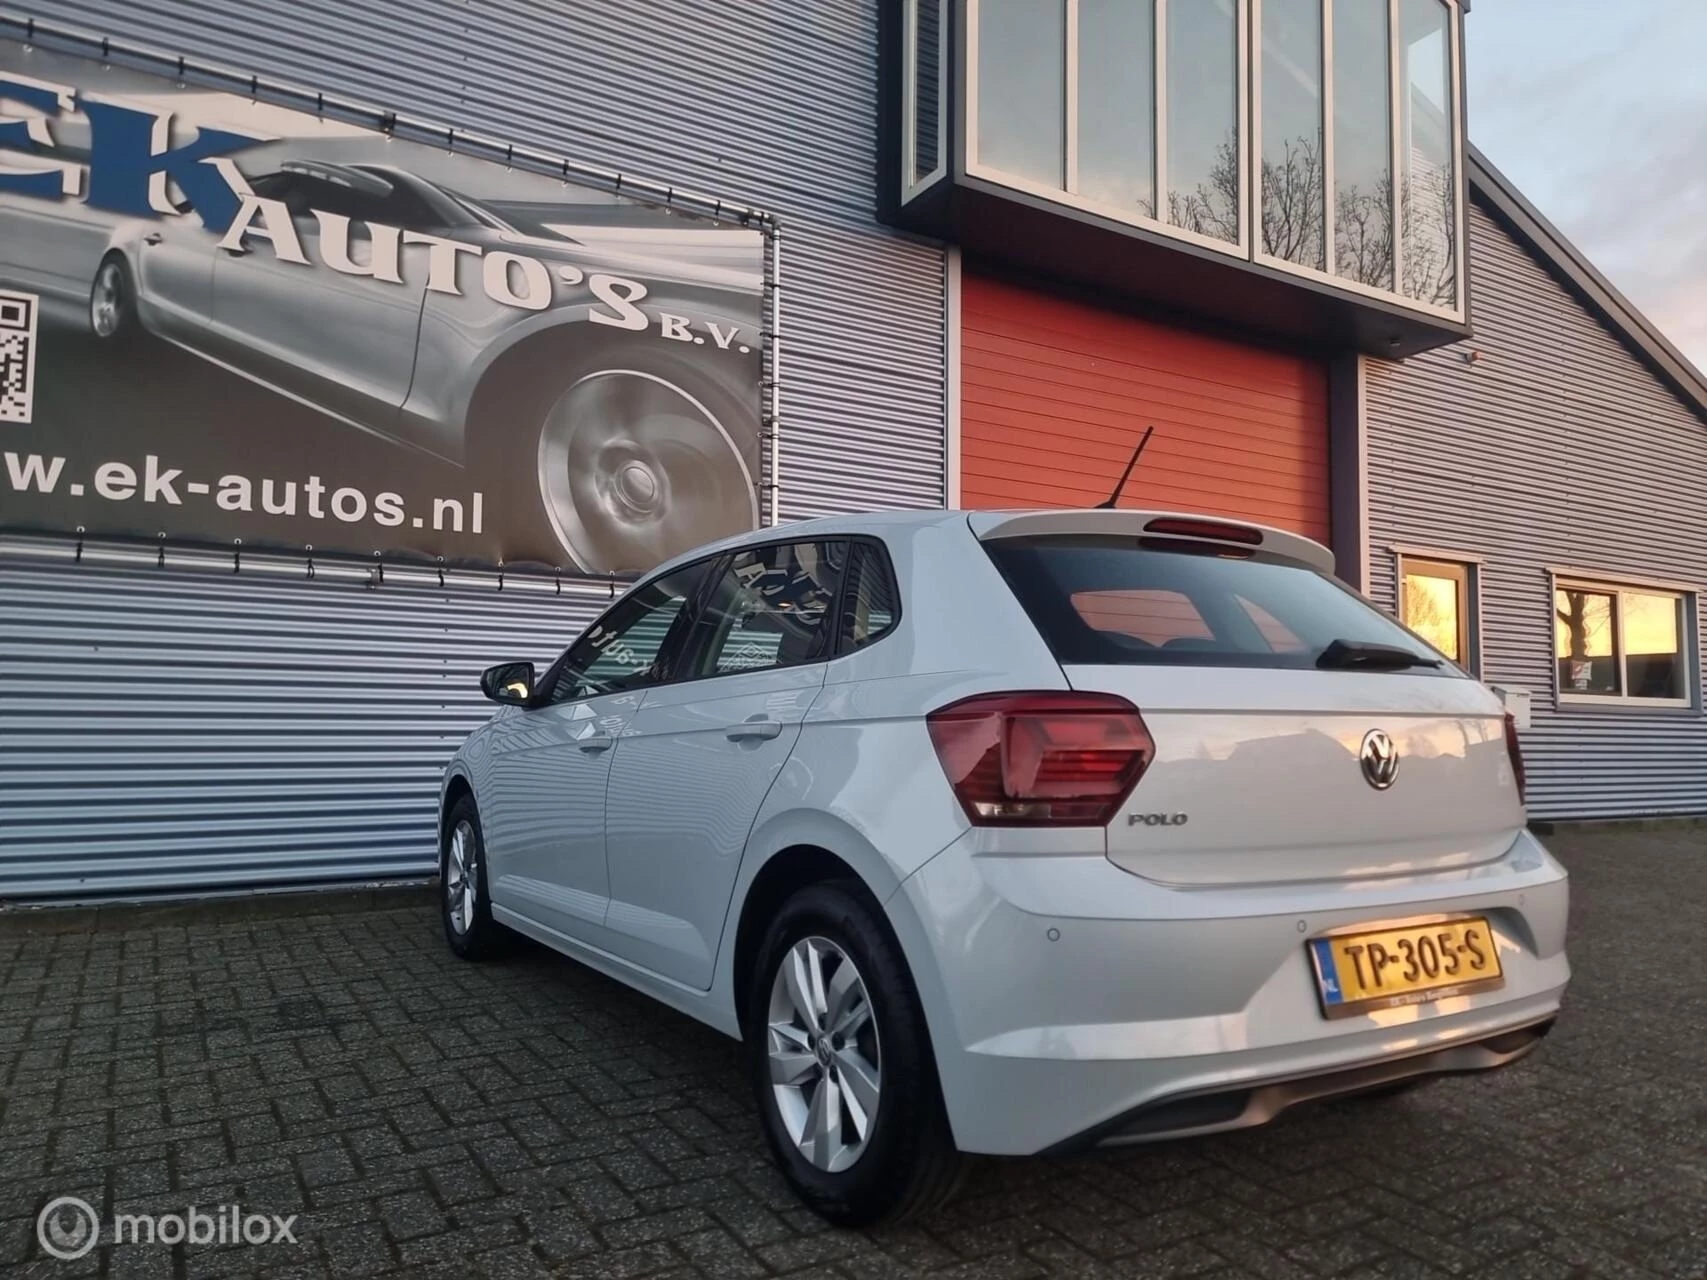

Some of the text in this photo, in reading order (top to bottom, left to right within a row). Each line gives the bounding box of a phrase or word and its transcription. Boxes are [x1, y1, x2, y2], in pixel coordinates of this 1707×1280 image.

[659, 311, 750, 354] B.V.
[1127, 811, 1189, 827] POLO
[1343, 929, 1487, 991] TP-305-S
